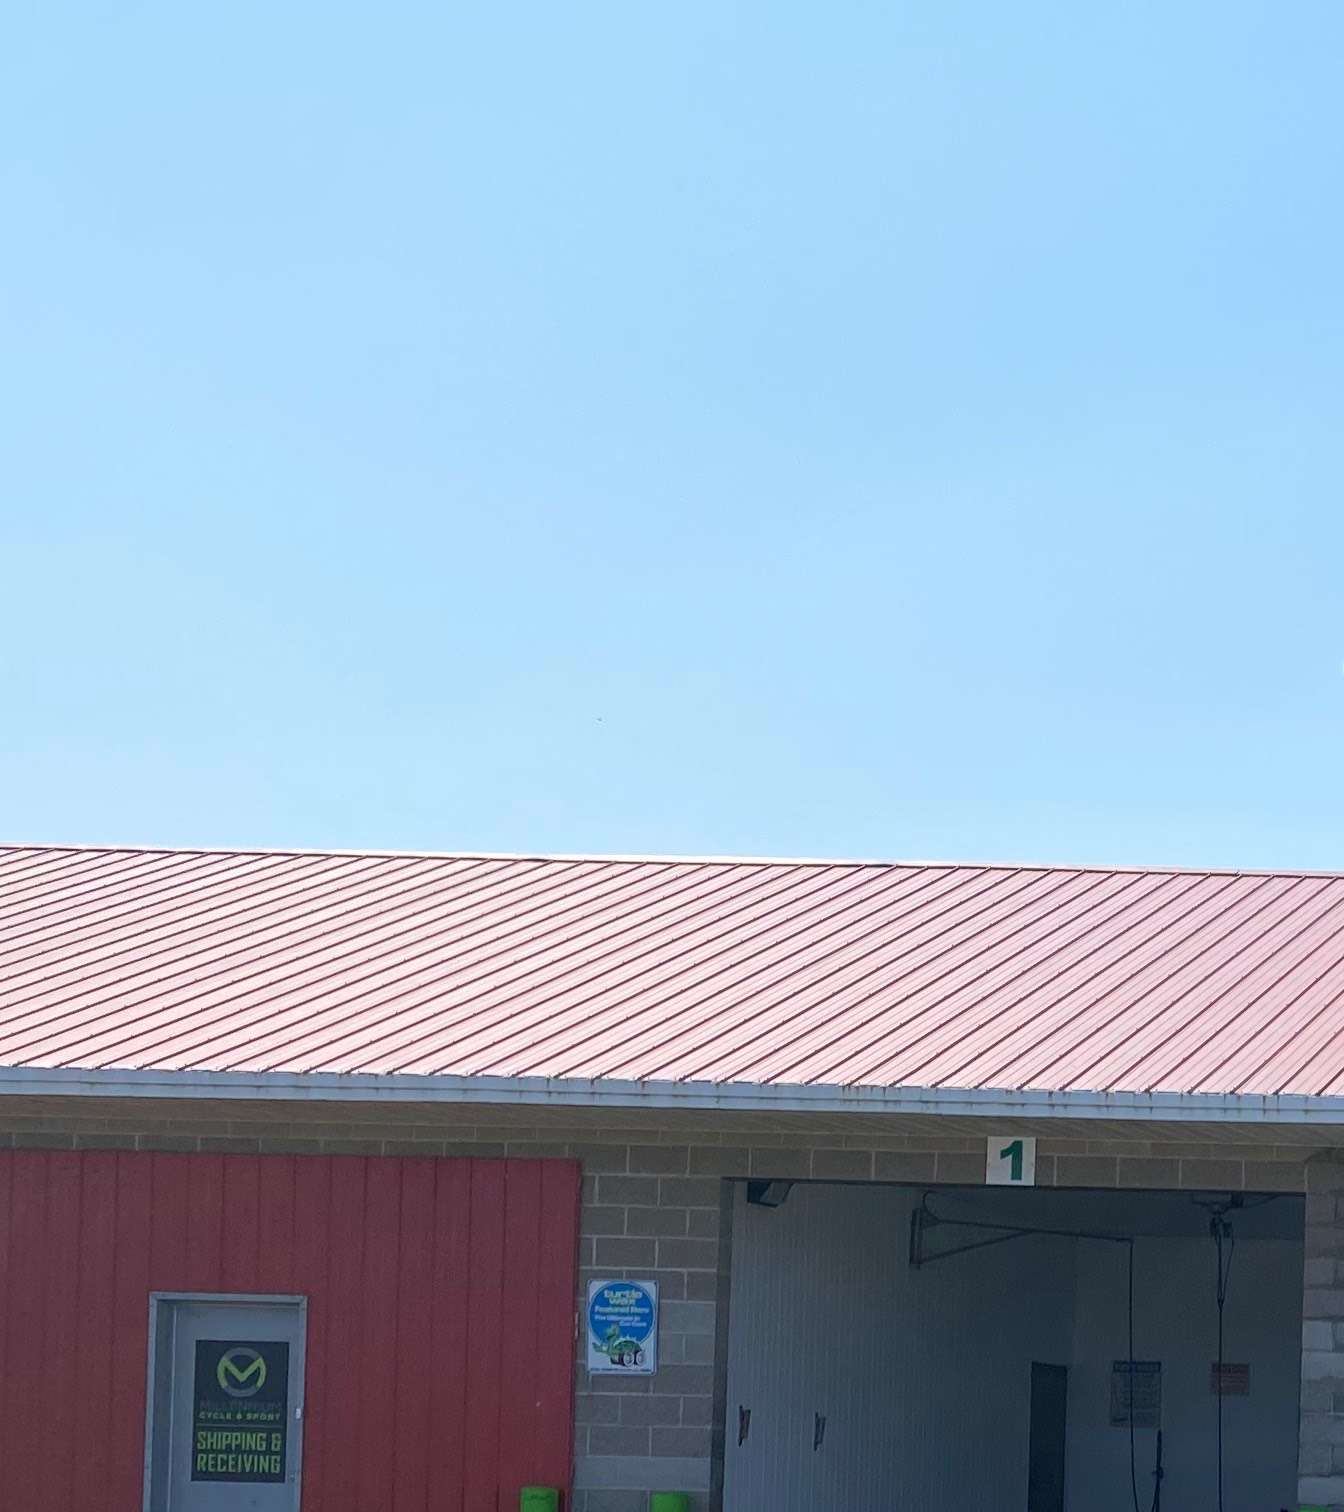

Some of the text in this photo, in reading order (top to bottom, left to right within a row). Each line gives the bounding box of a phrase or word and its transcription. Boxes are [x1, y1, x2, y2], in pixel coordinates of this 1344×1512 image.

[1000, 1140, 1023, 1180] 1
[199, 1411, 232, 1420] CYCLE
[246, 1412, 281, 1421] SPORT
[197, 1431, 282, 1452] SHIPPING &
[196, 1453, 281, 1474] RECEIVING
